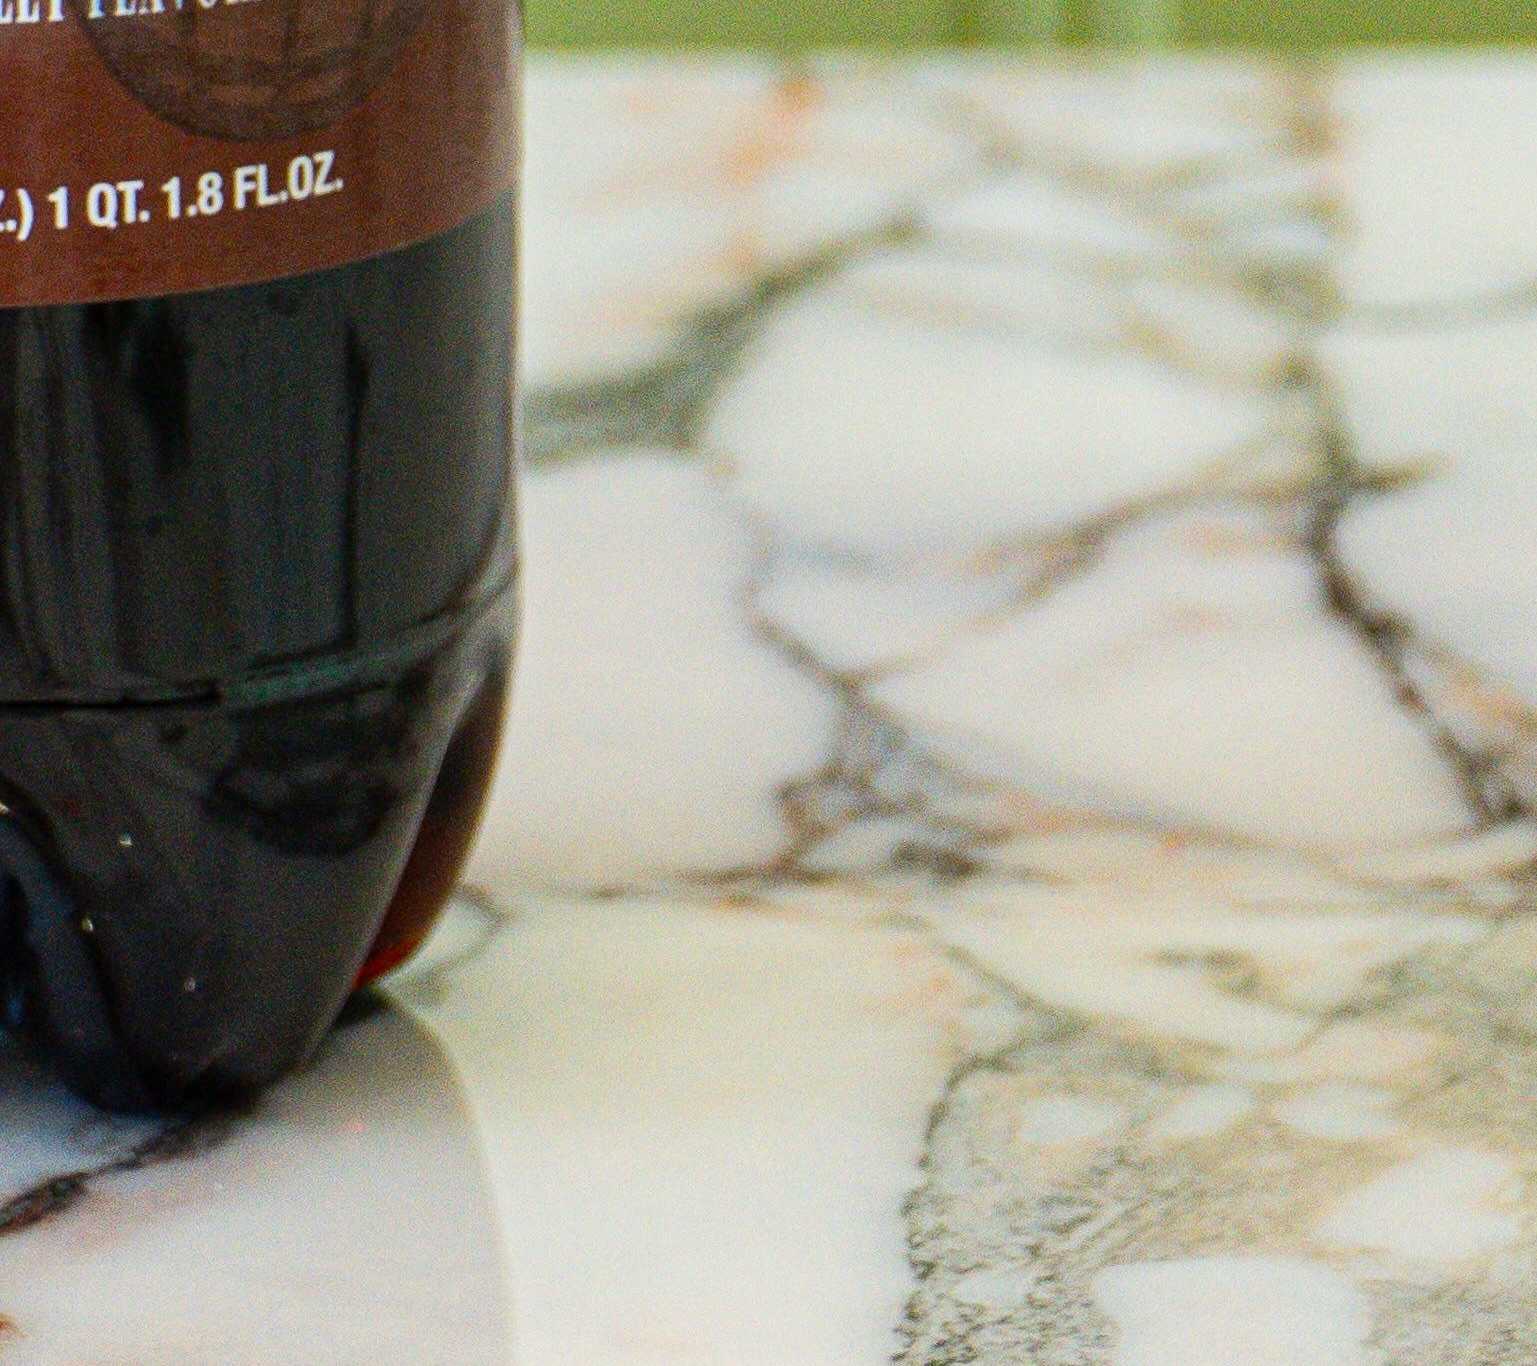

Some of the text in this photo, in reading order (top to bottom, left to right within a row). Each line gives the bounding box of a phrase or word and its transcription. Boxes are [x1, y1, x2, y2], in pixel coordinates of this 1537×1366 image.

[47, 186, 69, 230] 1
[85, 180, 150, 229] QT.
[161, 171, 224, 219] 1.8
